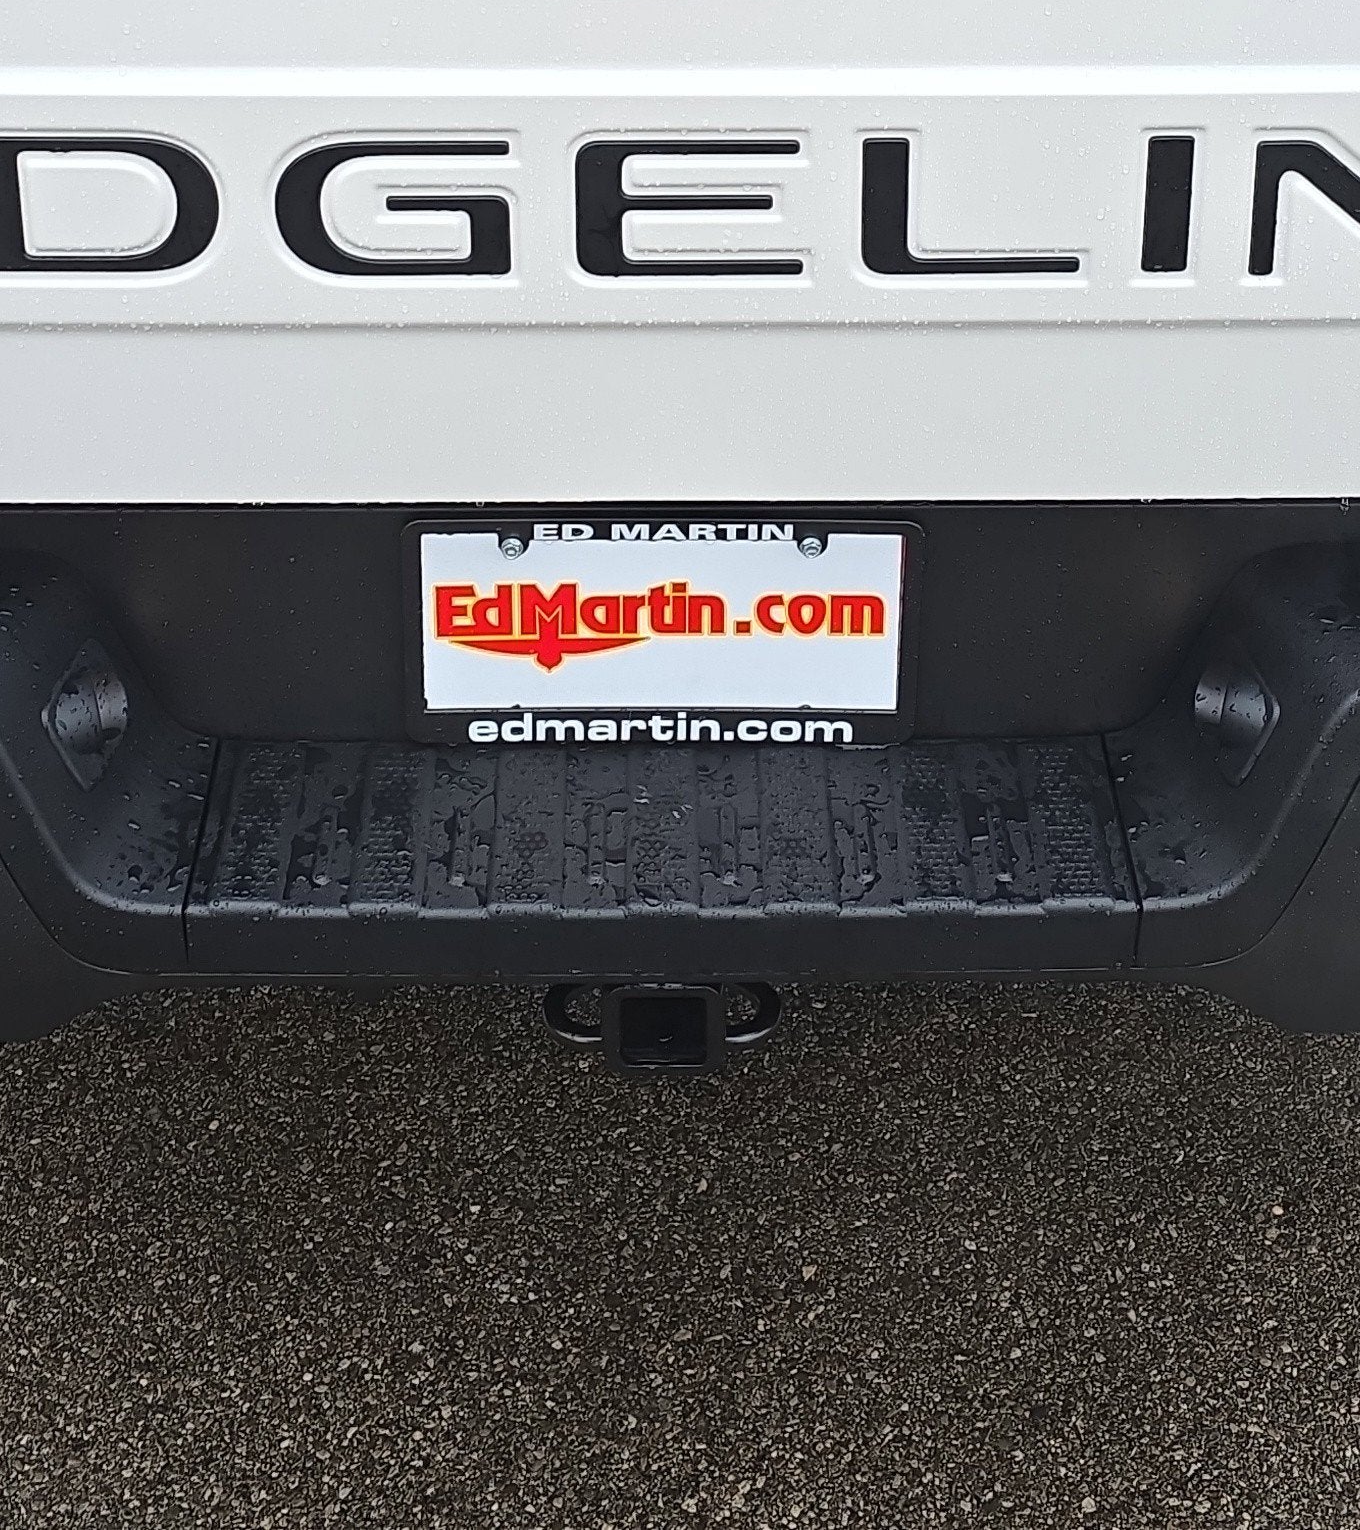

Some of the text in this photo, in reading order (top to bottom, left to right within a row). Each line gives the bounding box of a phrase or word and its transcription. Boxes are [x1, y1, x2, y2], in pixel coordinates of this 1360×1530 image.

[533, 523, 794, 541] ED MARTIN
[468, 712, 854, 743] edmartin.com
